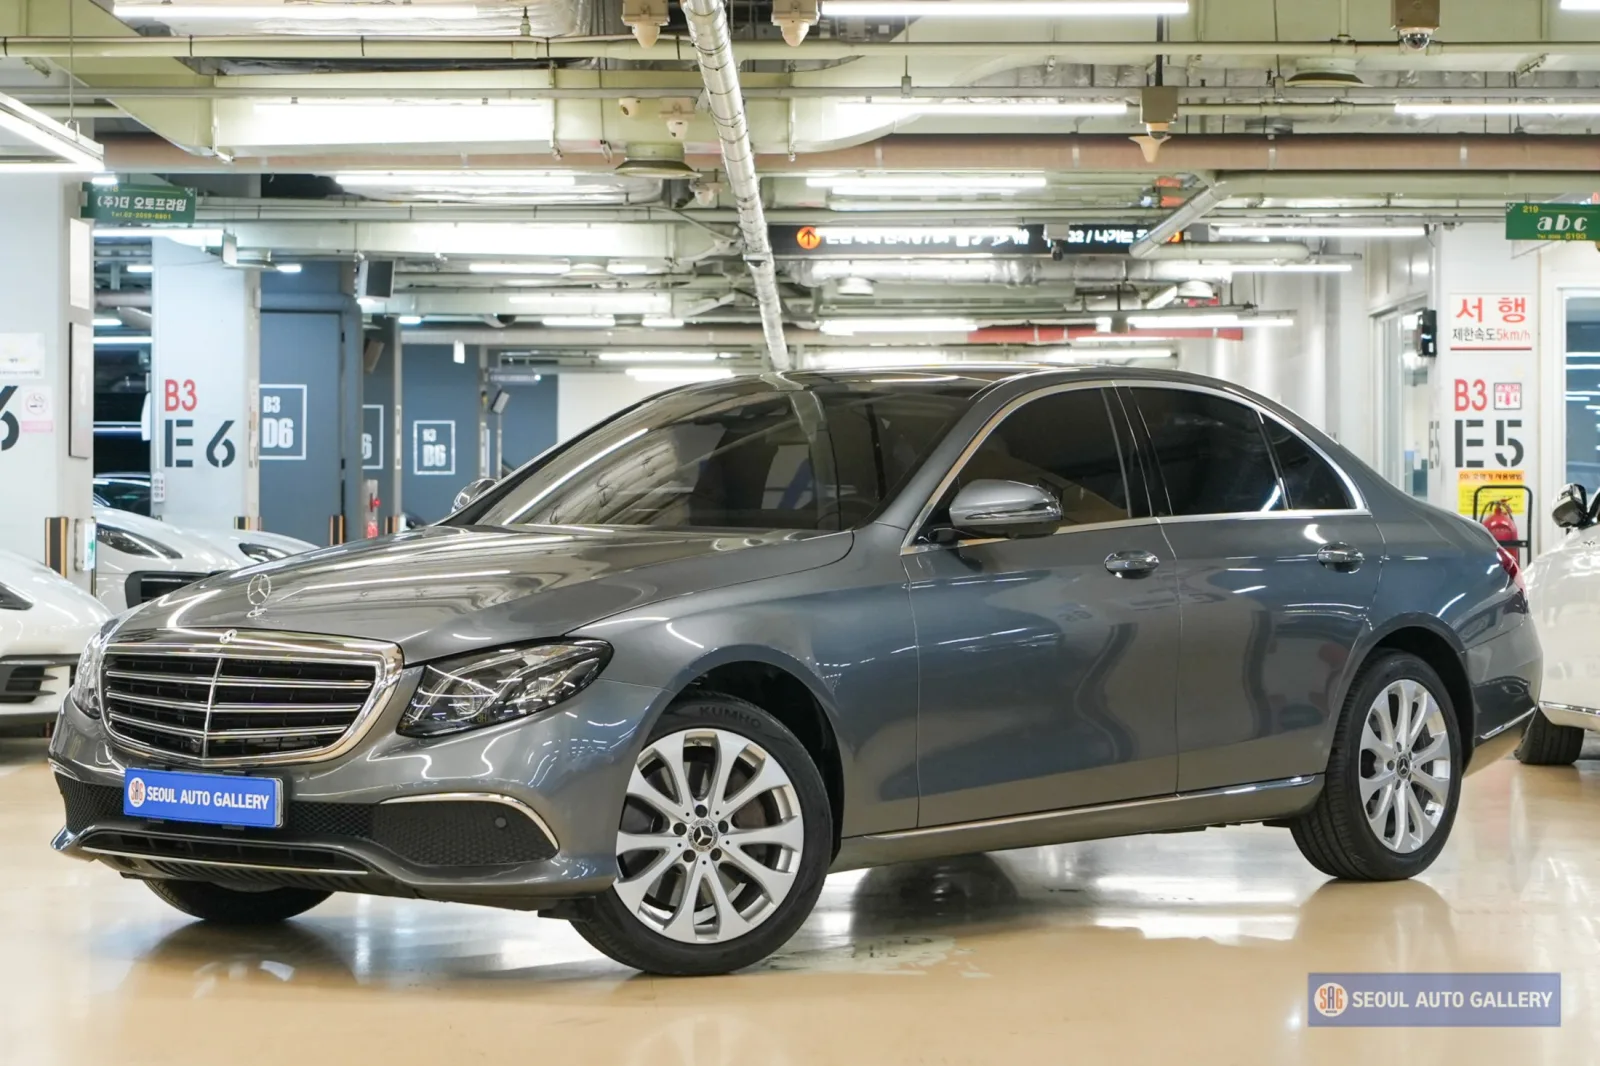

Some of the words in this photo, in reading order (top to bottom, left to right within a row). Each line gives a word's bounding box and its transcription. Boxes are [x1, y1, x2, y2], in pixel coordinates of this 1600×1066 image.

[97, 195, 129, 209] (주)더
[134, 196, 187, 212] 오토프라임
[1522, 205, 1539, 213] 219
[1537, 214, 1588, 231] abc
[165, 379, 197, 411] B3
[262, 395, 281, 413] B3
[1454, 379, 1488, 411] B3
[262, 417, 294, 449] D6
[700, 706, 761, 728] KUMHO
[146, 785, 177, 803] SEOUL
[180, 789, 210, 806] AUTO
[213, 791, 270, 810] GALLERY
